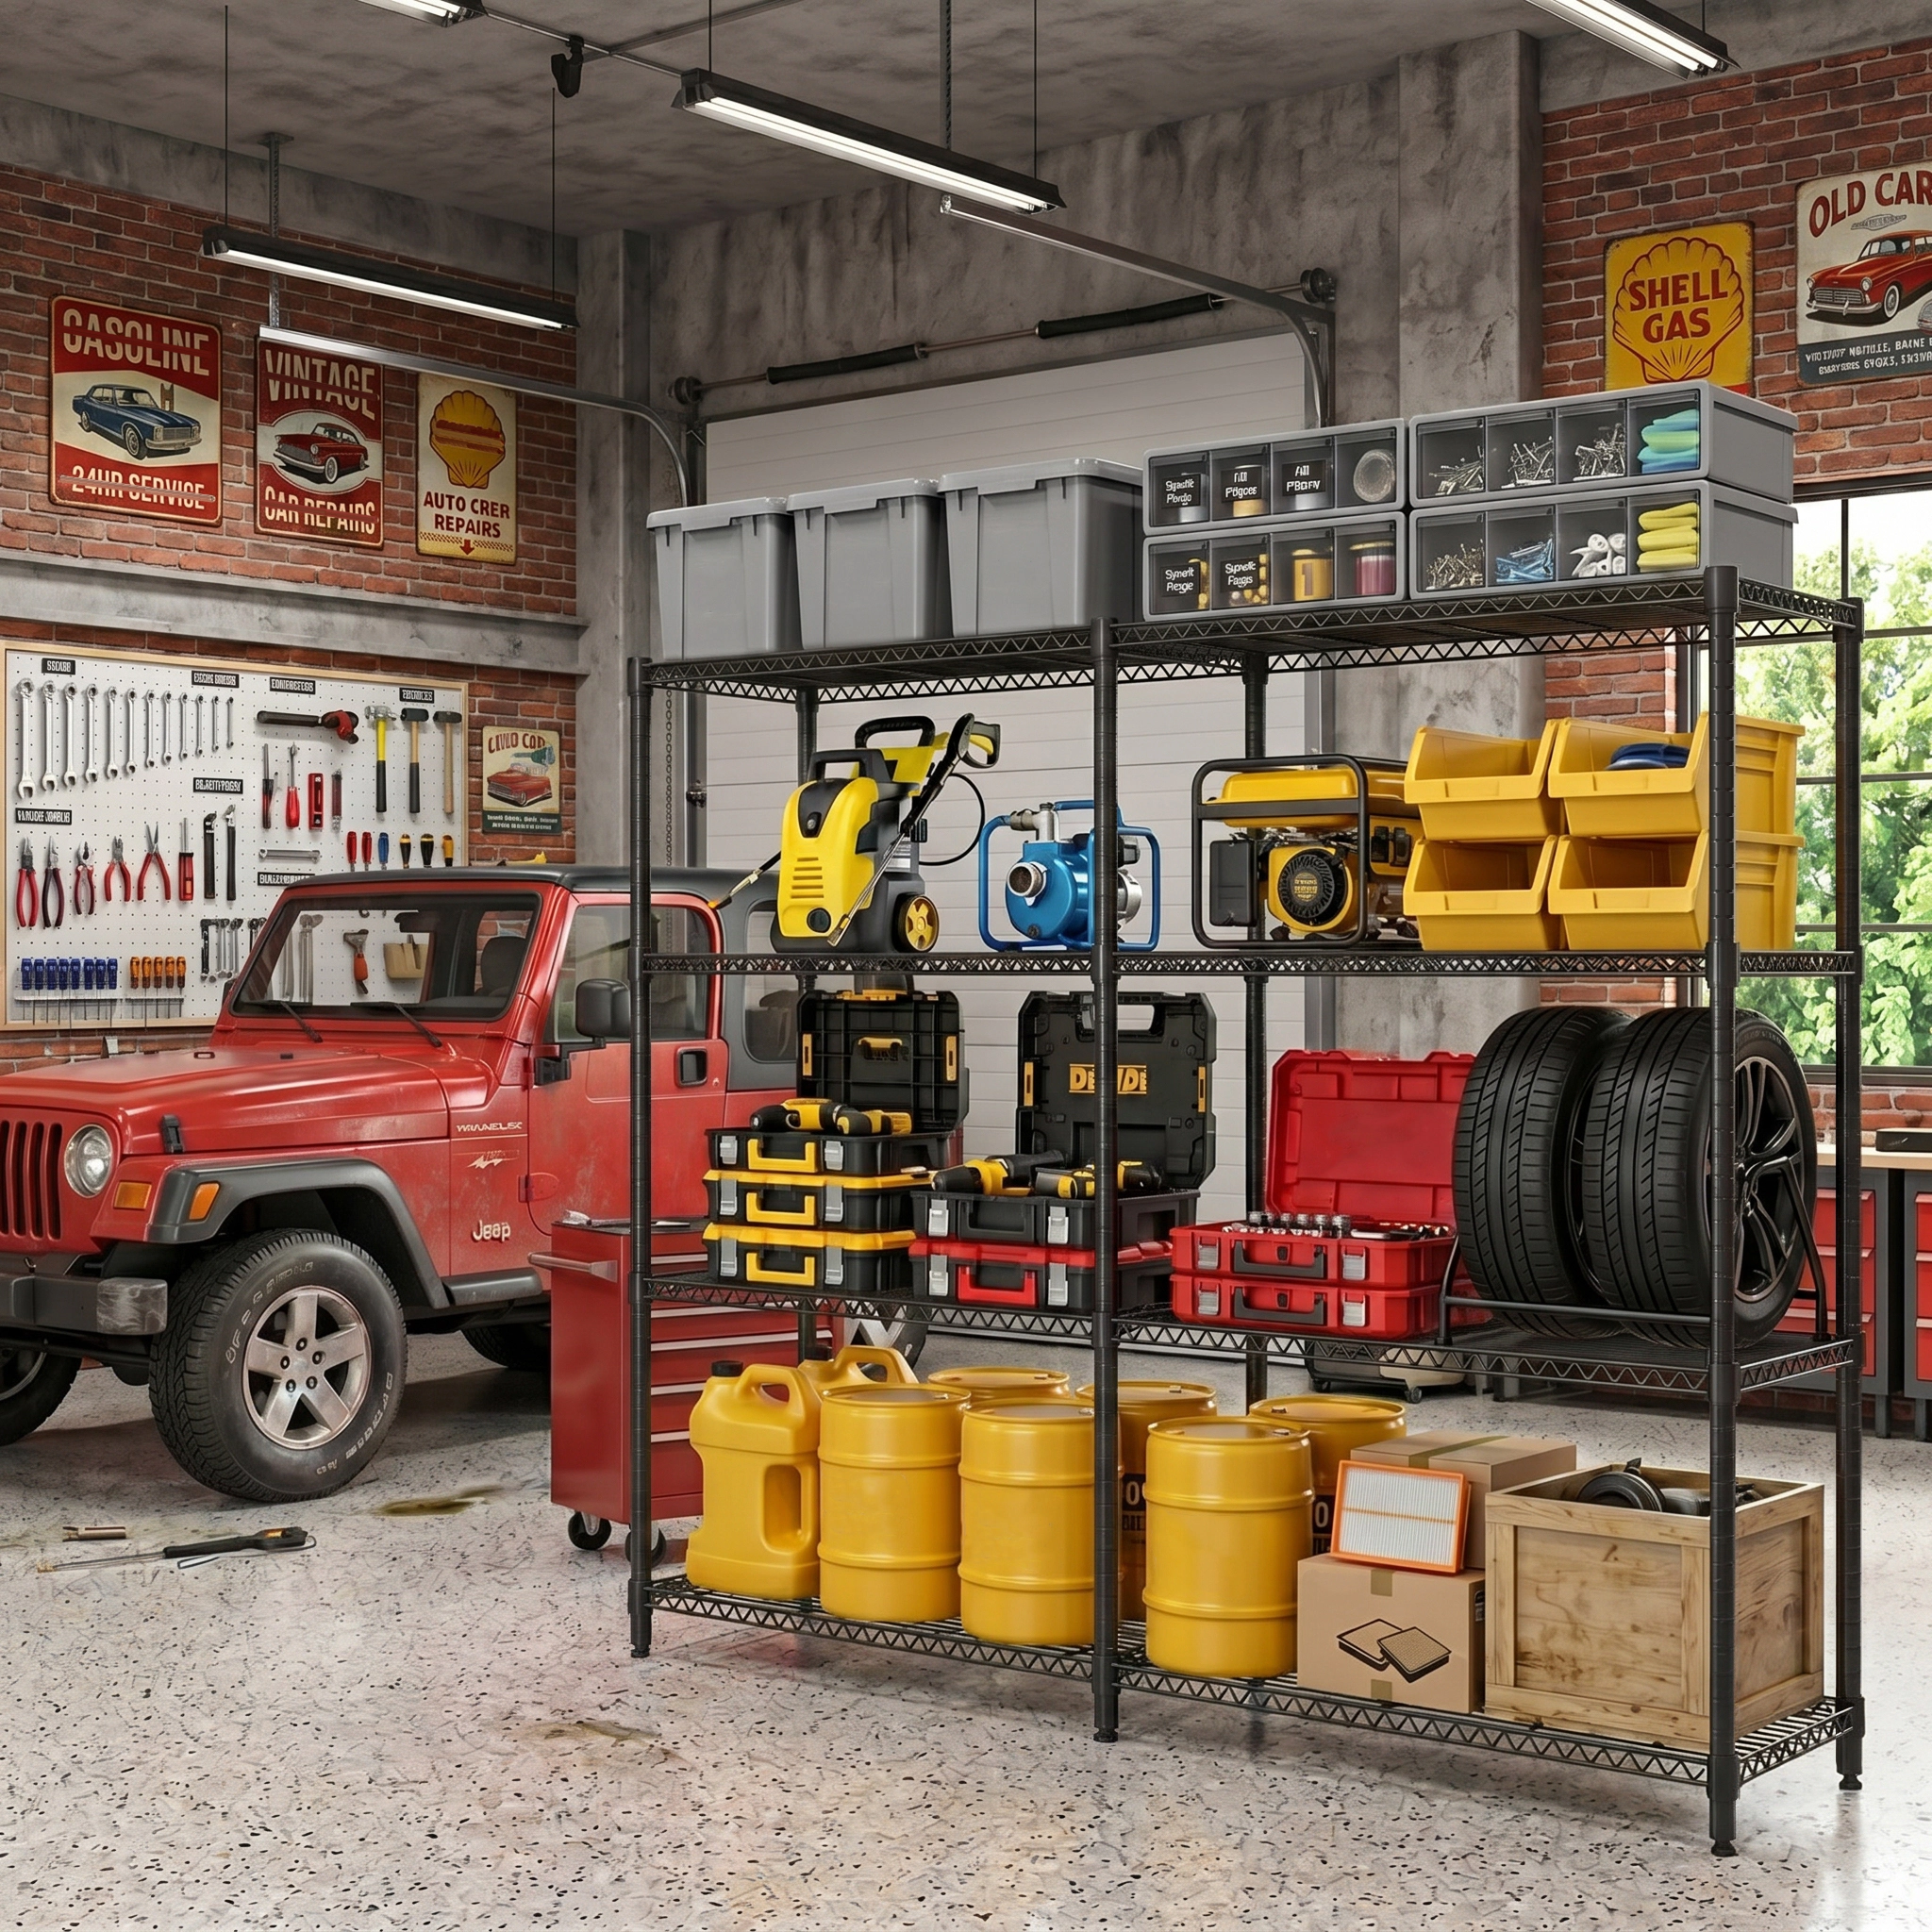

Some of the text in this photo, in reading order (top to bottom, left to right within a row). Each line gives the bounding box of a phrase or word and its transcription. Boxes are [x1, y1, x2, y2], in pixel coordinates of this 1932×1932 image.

[1809, 180, 1866, 238] OLD
[1628, 269, 1728, 312] SHELL
[63, 308, 209, 377] GASOLINE
[1642, 308, 1711, 344] GAS
[265, 349, 375, 421] VINTAGE
[72, 465, 205, 510] 24HR SERVICE
[265, 485, 375, 535] CAR REPAIRS
[423, 491, 510, 520] AUTO CRER
[434, 513, 501, 539] REPAIRS
